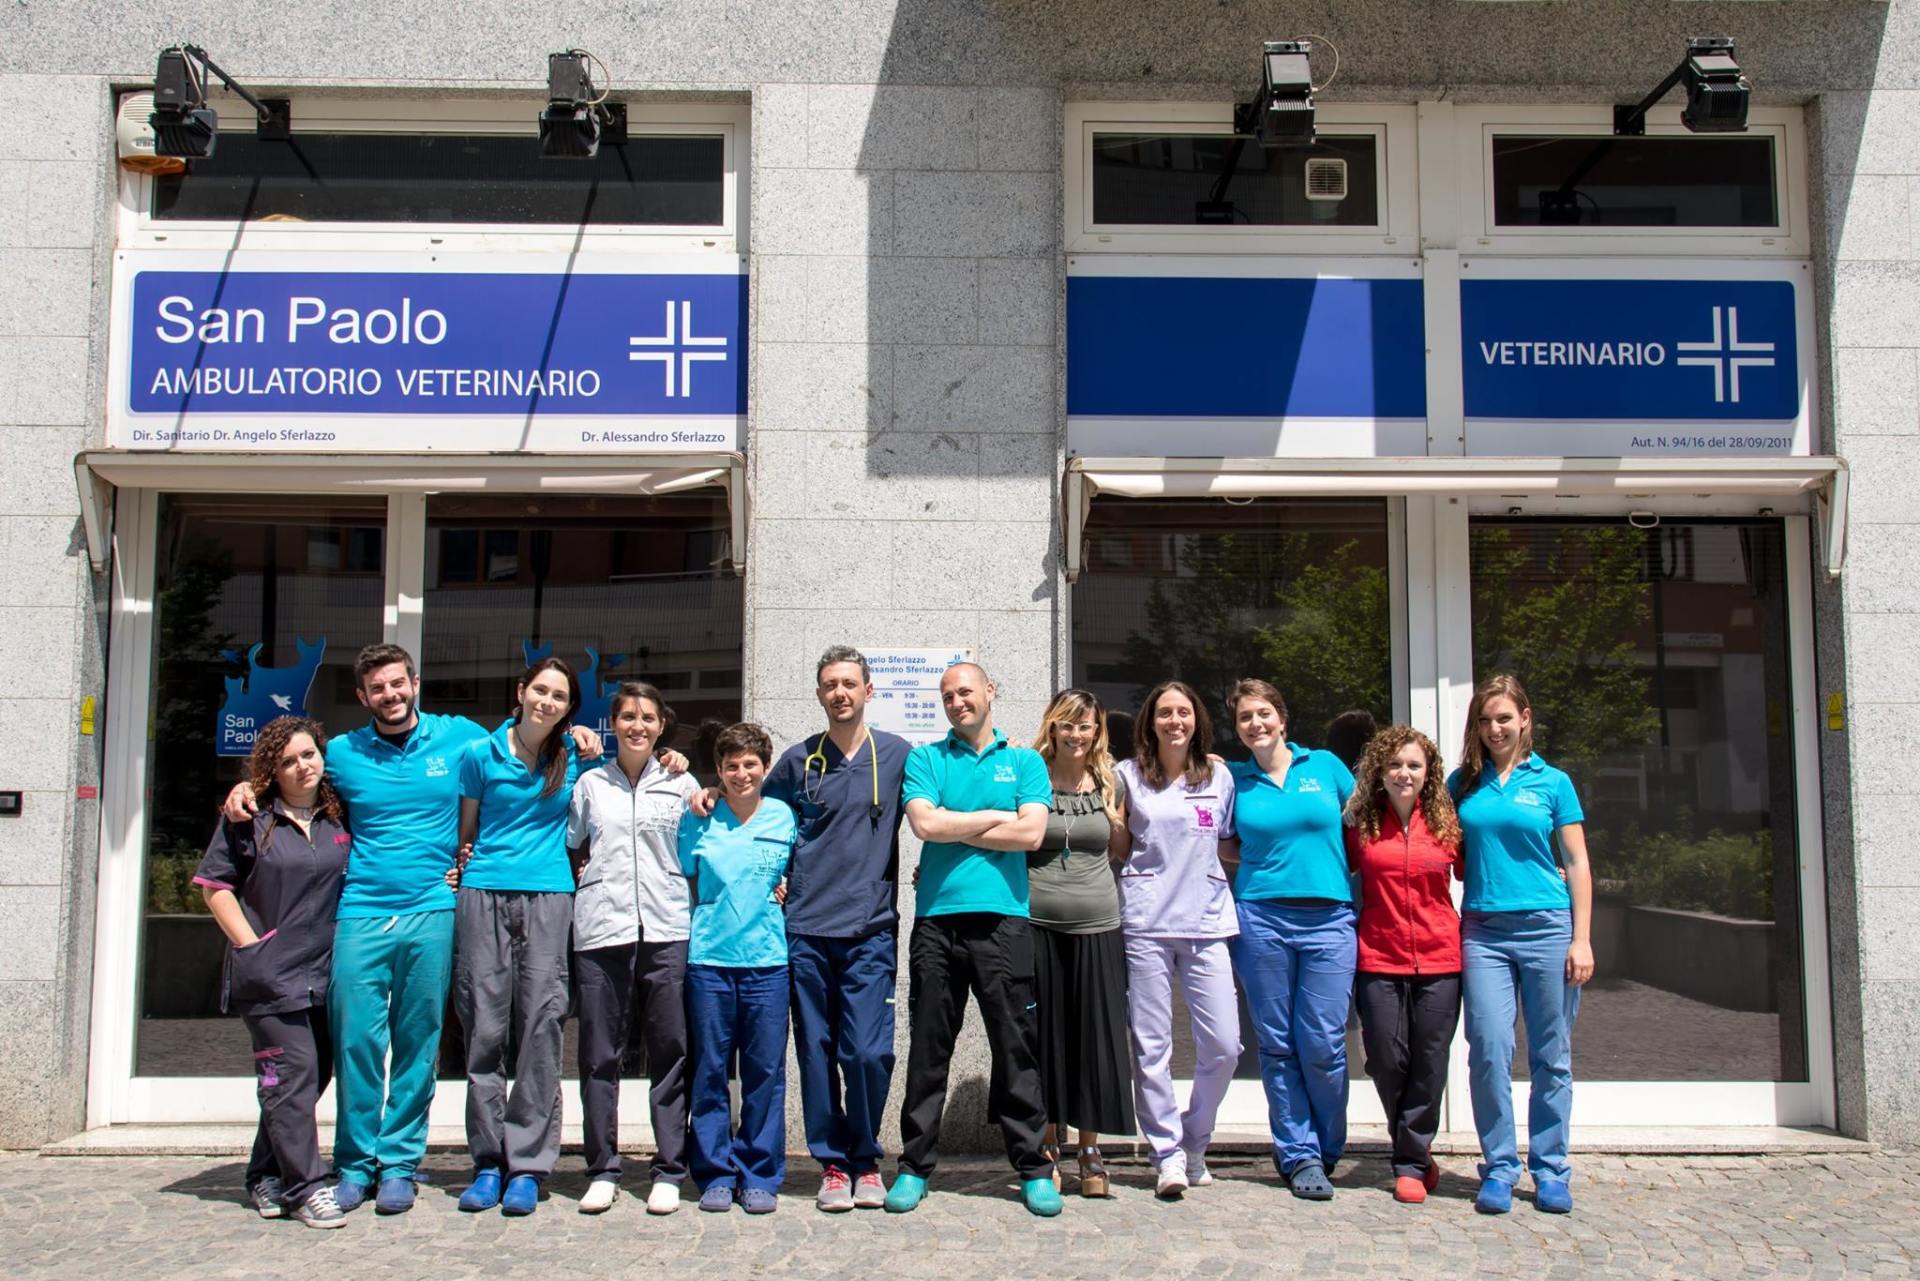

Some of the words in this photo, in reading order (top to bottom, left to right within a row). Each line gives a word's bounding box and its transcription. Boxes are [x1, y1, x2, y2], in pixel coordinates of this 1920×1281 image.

[155, 296, 265, 345] San
[288, 297, 447, 346] Paolo
[1479, 340, 1666, 367] VETERINARIO
[150, 366, 382, 397] AMBULATORIO
[396, 368, 601, 398] VETERINARIO
[133, 430, 154, 442] Dir.
[156, 430, 210, 442] Sanitario
[213, 430, 231, 442] Dr.
[233, 430, 277, 444] Angelo
[280, 430, 336, 442] Sferlazzo
[581, 431, 600, 443] Dr.
[602, 431, 669, 443] Alessandro
[671, 431, 726, 443] Sferlazzo
[1631, 436, 1655, 449] Aut.
[1657, 436, 1669, 448] N.
[1672, 436, 1705, 449] 94/16
[1707, 436, 1726, 448] del
[1729, 436, 1792, 450] 28/09/2011
[224, 714, 255, 727] San
